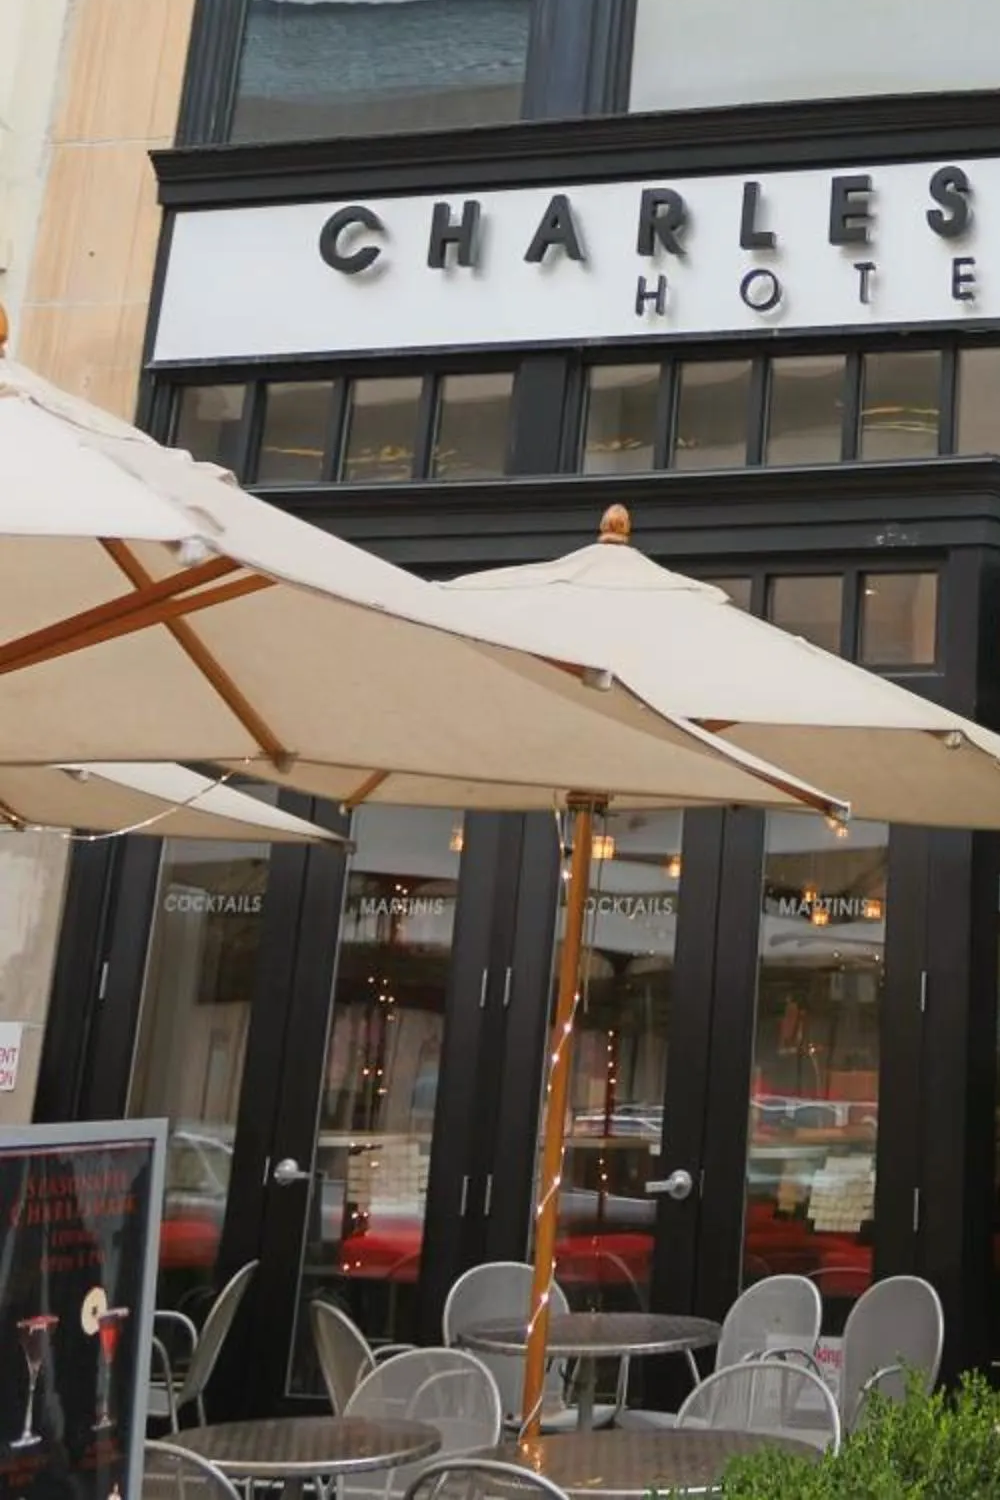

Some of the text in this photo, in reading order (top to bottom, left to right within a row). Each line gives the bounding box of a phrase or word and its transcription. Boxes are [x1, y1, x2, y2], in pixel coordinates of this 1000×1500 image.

[163, 895, 263, 914] COCKTAILS
[360, 897, 445, 917] MARTINIS
[584, 896, 674, 916] OCKTAILS
